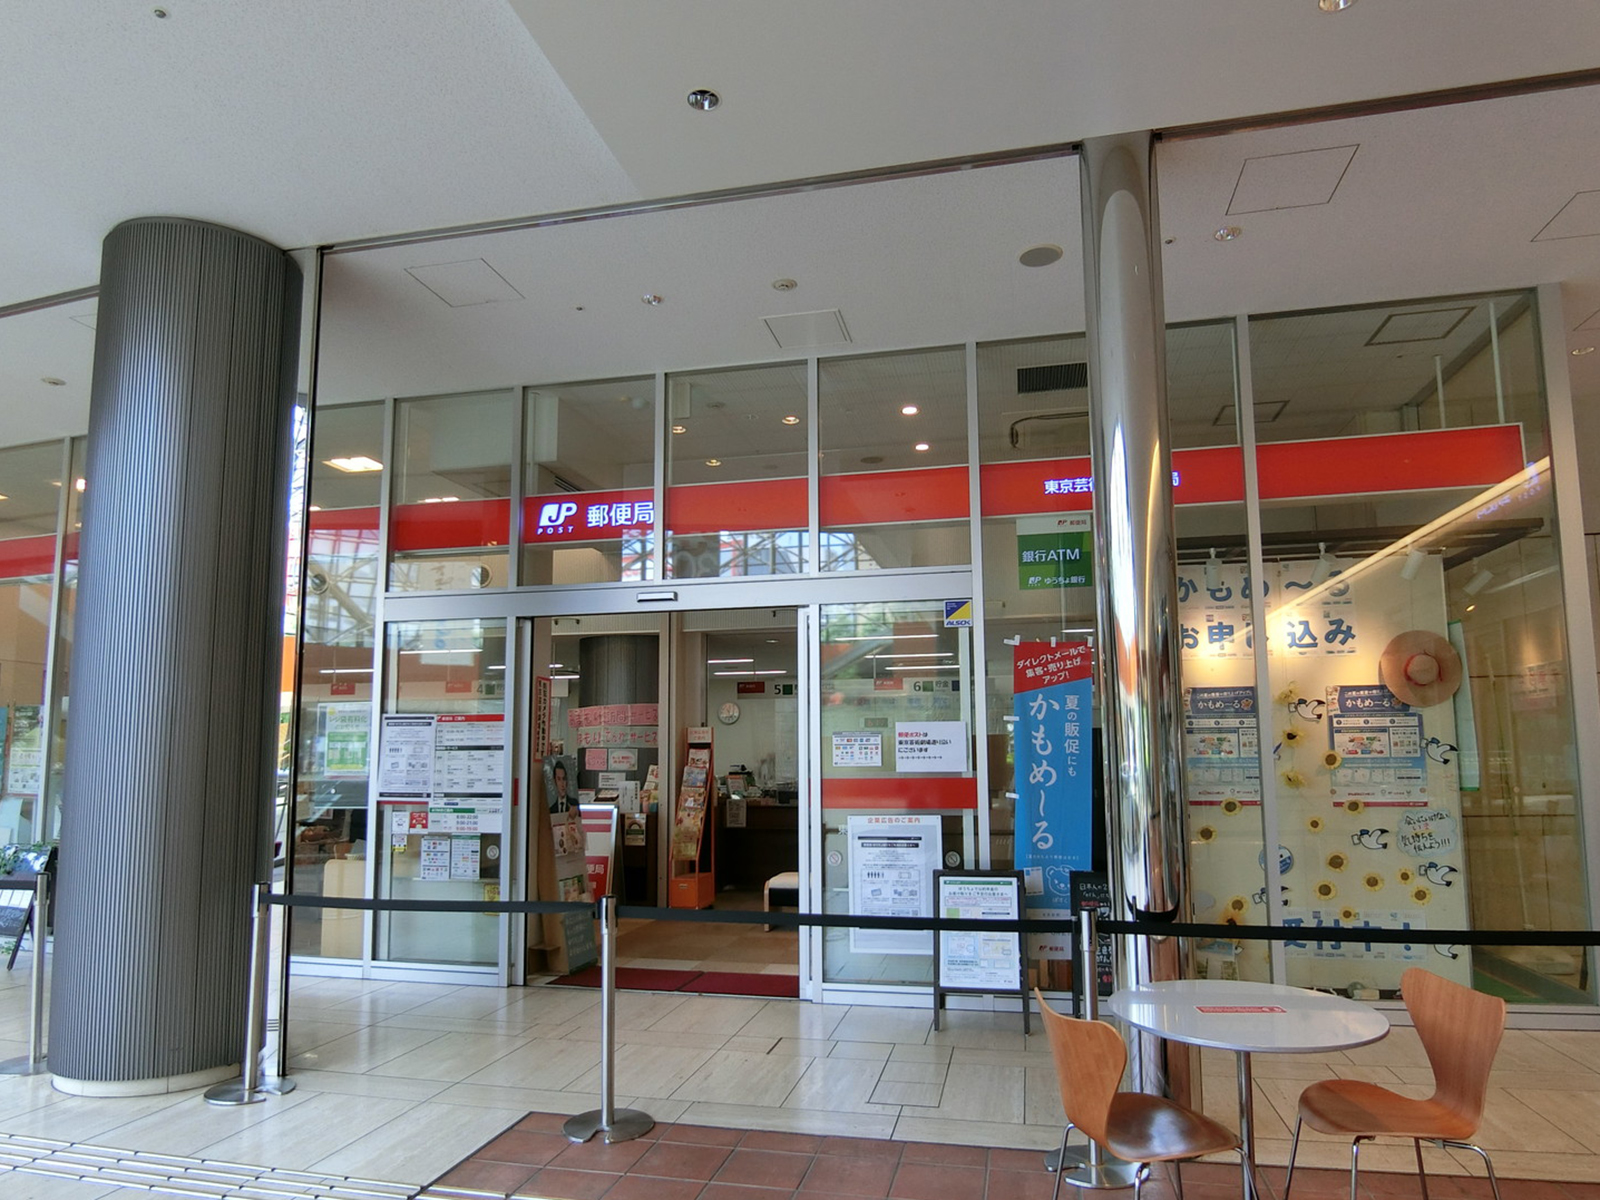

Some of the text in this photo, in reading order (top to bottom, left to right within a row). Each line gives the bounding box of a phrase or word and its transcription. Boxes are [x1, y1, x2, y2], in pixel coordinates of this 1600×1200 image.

[1044, 477, 1094, 495] 東京芸
[587, 502, 654, 527] 郵便局
[537, 526, 574, 535] POST
[1022, 548, 1080, 563] 銀行ATM
[1044, 575, 1086, 585] ゆうちょ銀行
[1016, 645, 1086, 669] ダイレクトメールで
[1025, 657, 1081, 678] 集客・売り上げ
[1042, 671, 1070, 685] アップ!
[476, 684, 484, 694] 4
[774, 684, 782, 695] 5
[913, 681, 921, 692] 6
[1197, 700, 1241, 710] かもめ～る
[1345, 698, 1390, 708] かもめ～る
[1064, 694, 1080, 777] 夏の販促にも
[1028, 693, 1060, 850] かもめ～る
